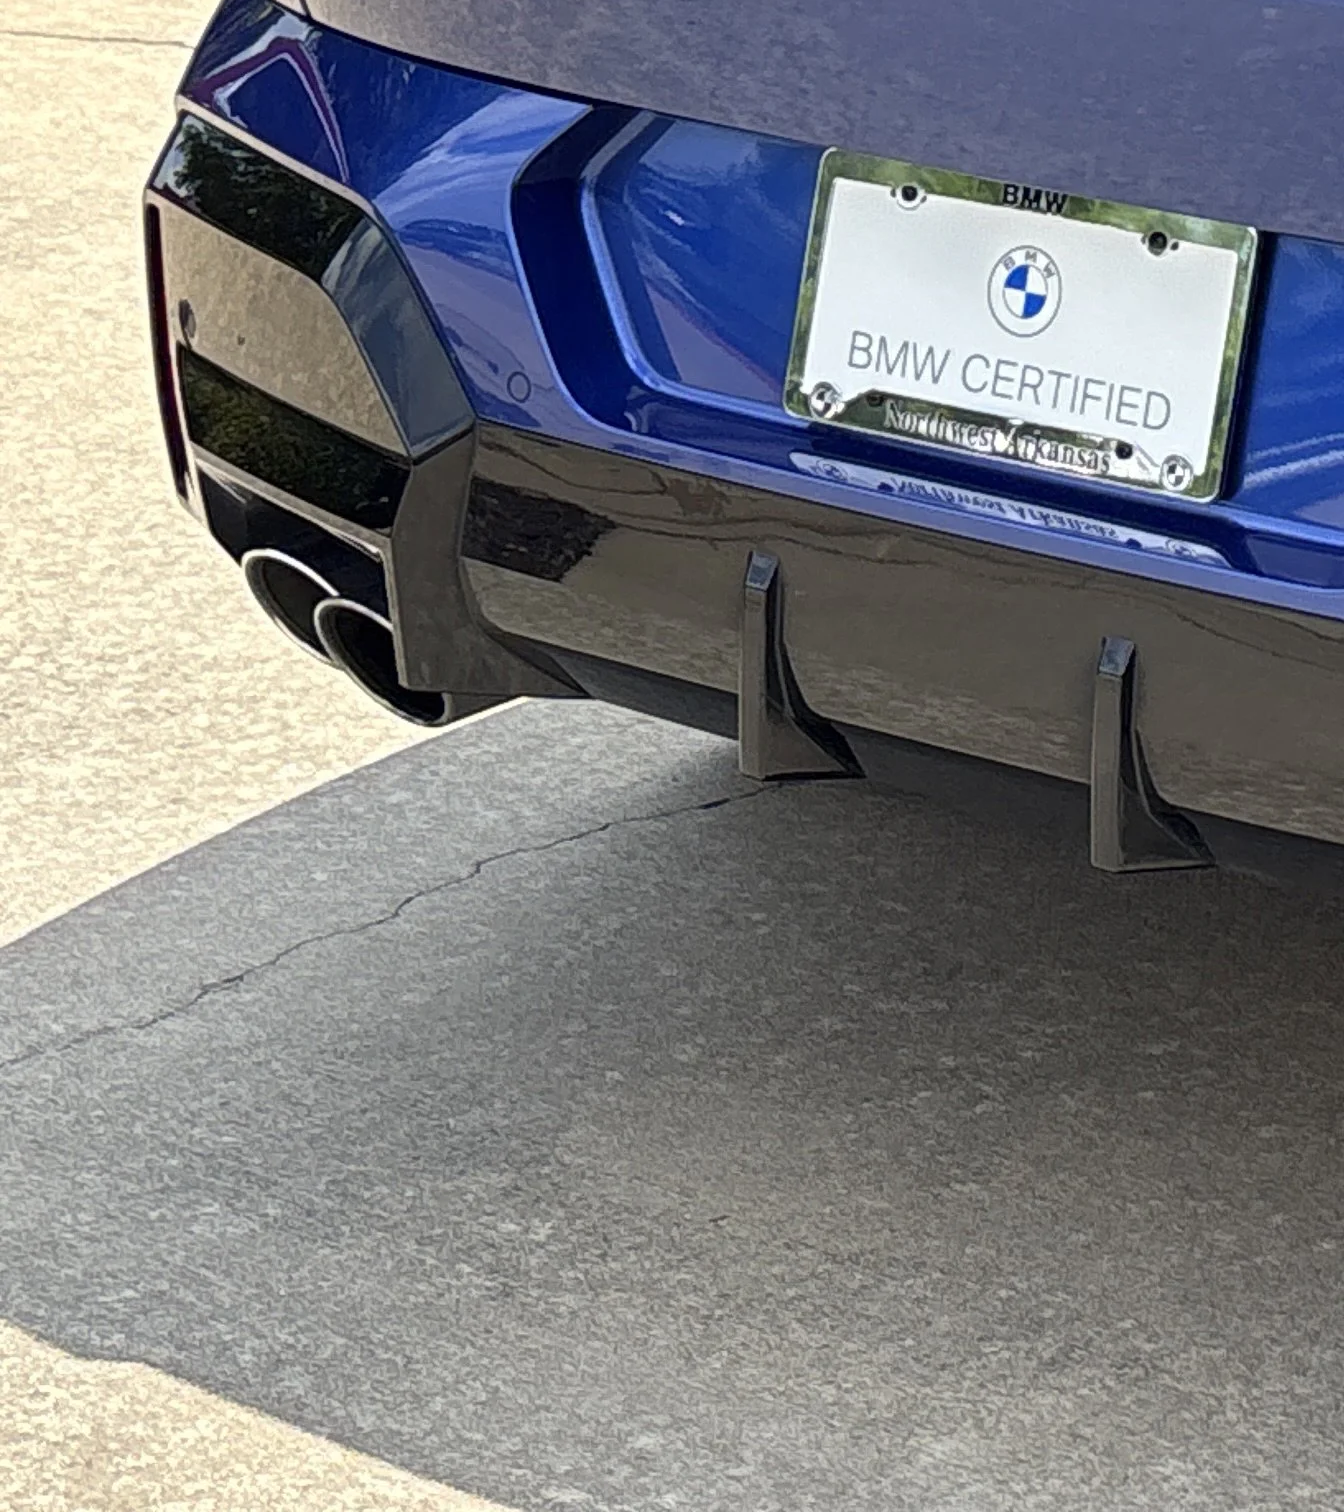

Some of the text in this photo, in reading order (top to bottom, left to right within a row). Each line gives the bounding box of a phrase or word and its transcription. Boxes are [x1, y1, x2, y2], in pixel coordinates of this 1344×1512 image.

[1002, 183, 1069, 215] BMW
[1003, 250, 1057, 279] BMW
[847, 330, 1172, 431] BMW CERTIFIED
[883, 399, 1112, 475] Northwest Arkansas
